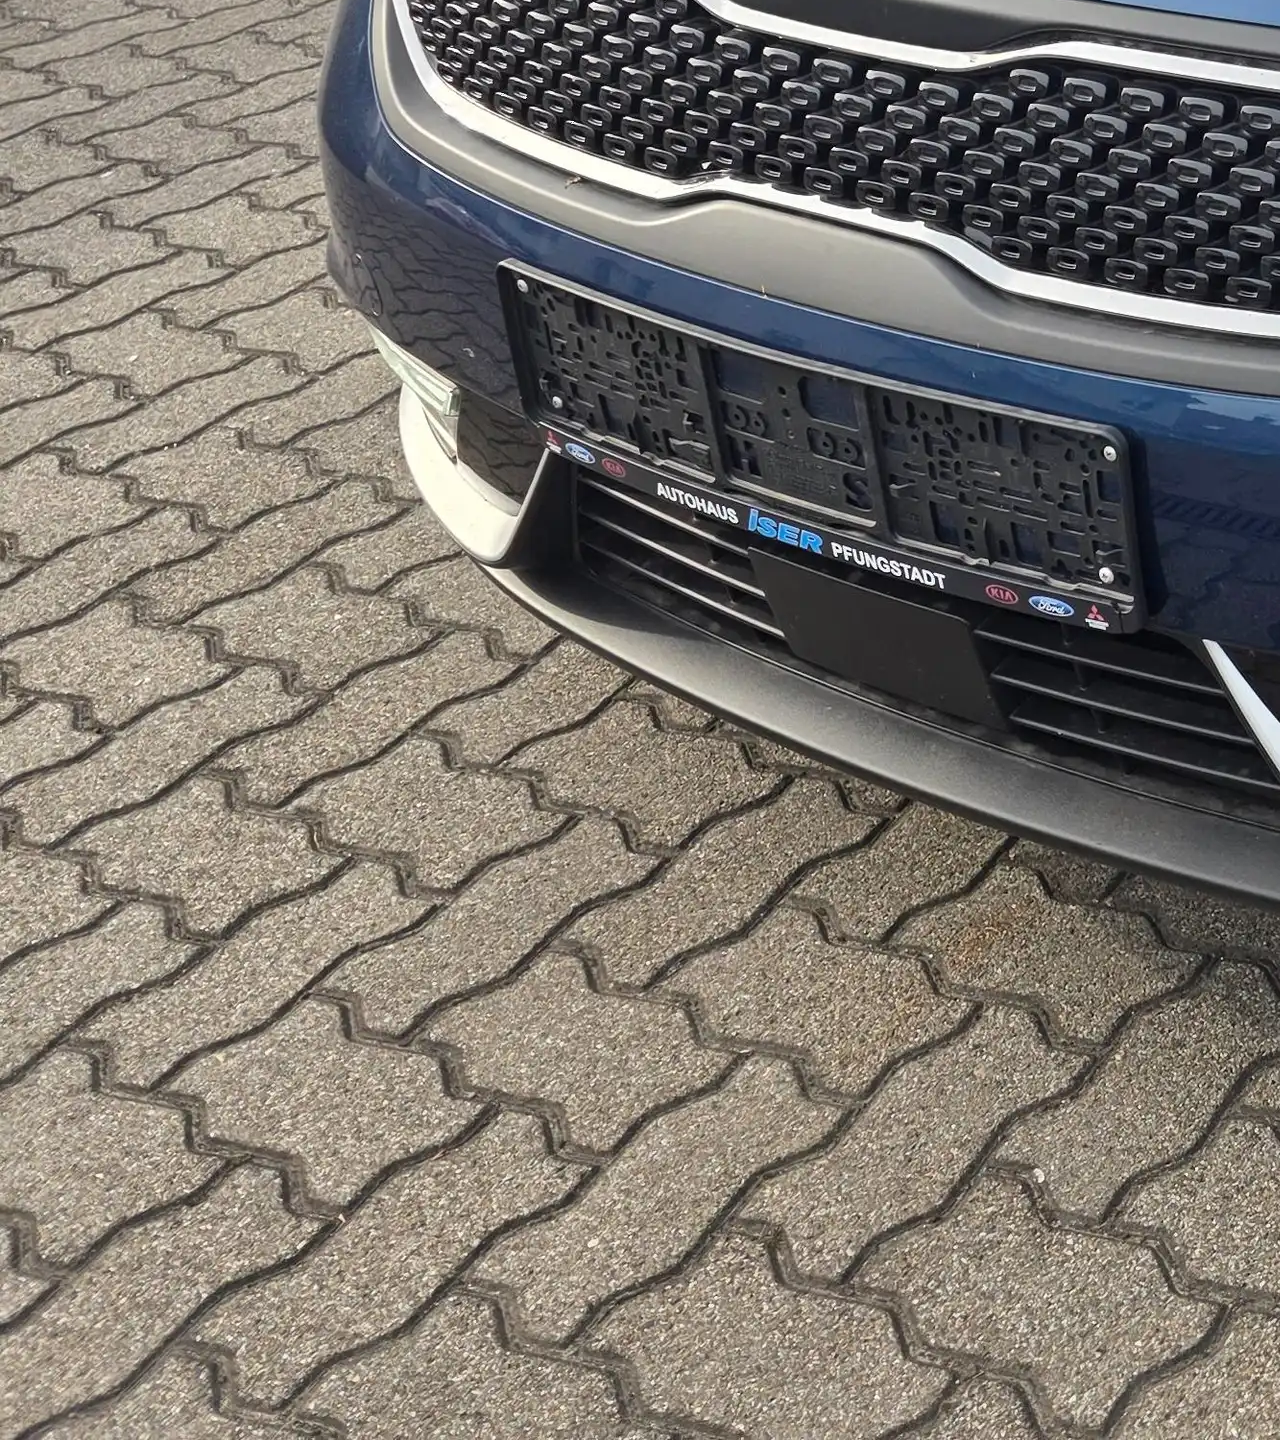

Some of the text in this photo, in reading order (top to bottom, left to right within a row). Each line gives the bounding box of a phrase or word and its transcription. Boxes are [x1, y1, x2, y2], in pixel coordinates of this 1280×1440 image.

[656, 482, 946, 589] AUTOHAUS ISER PFUNGSTADT
